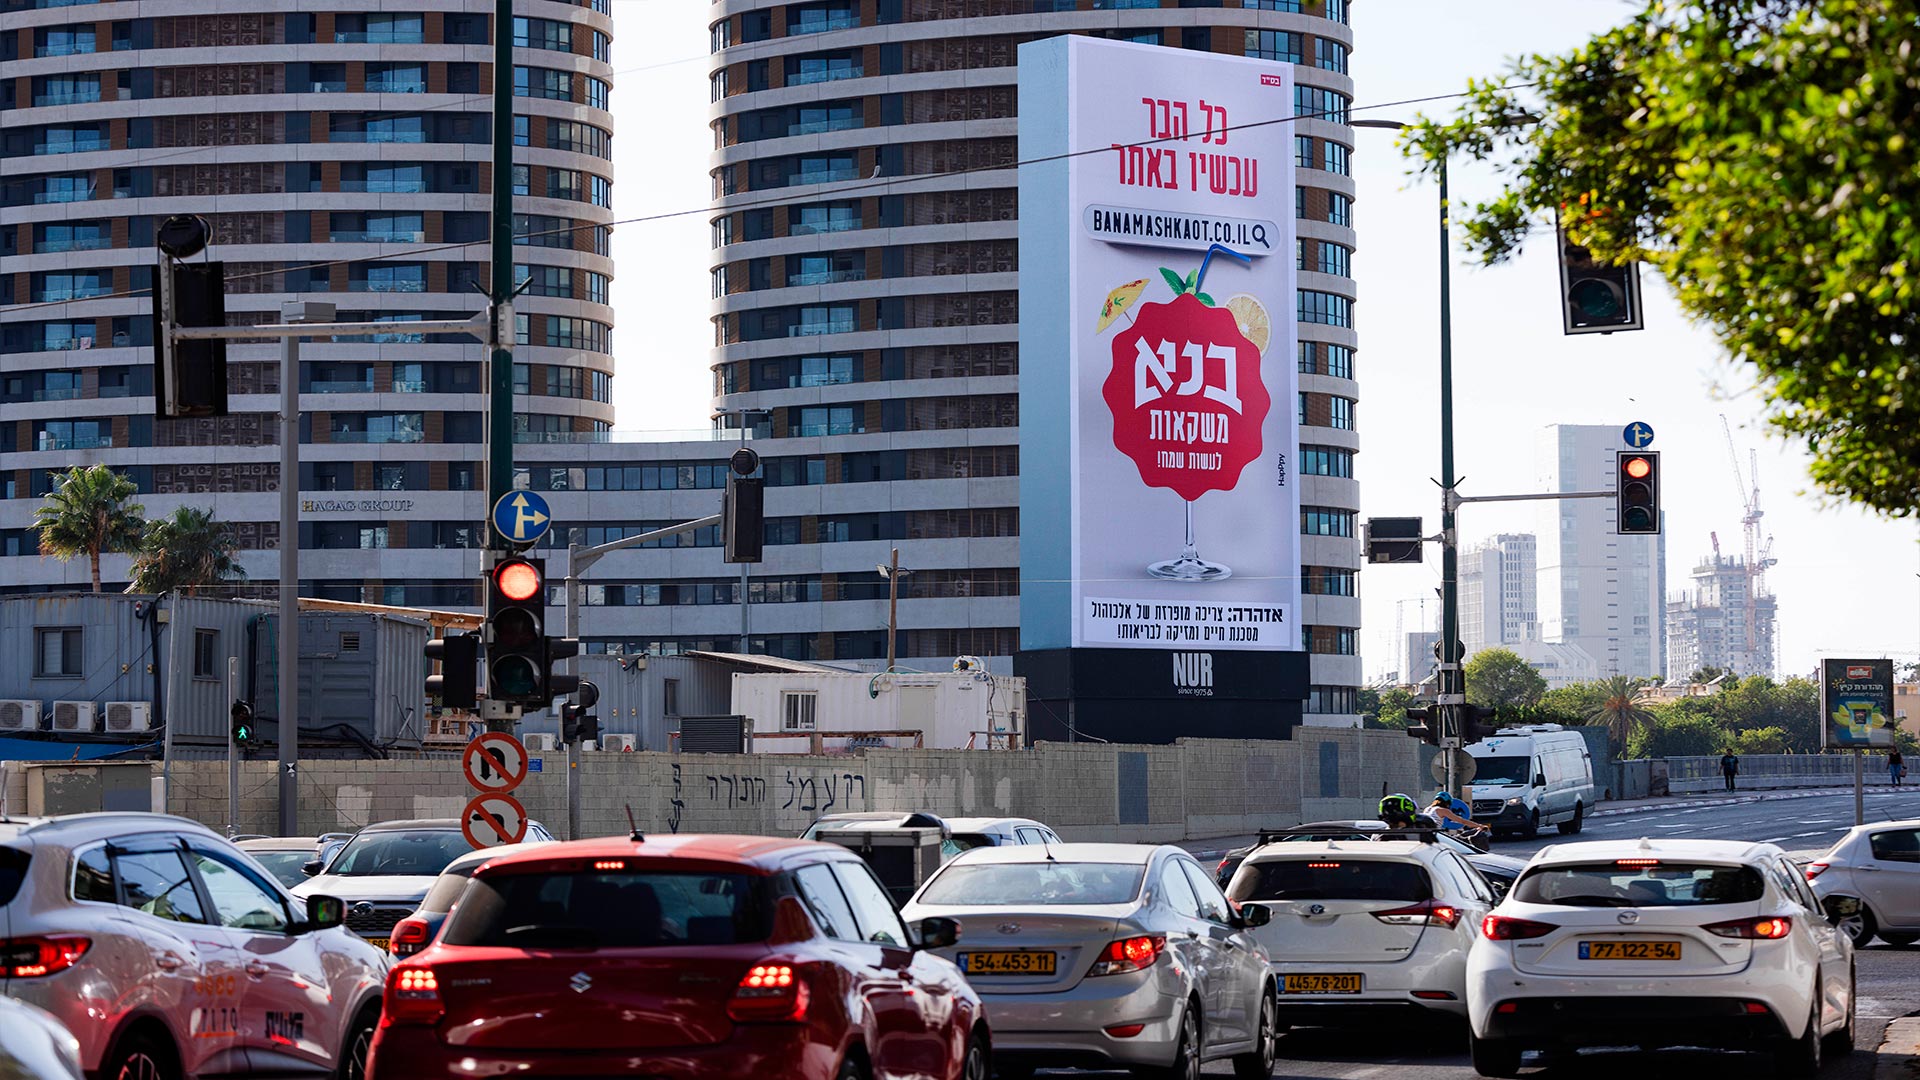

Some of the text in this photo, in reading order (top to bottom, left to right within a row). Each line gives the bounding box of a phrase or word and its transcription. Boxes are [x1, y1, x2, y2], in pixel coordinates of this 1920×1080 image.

[1142, 97, 1228, 145] כל הבר
[1111, 143, 1258, 198] עכשיו באתר
[1093, 209, 1251, 246] BANAMASHKAOT.CO.IL
[1149, 409, 1229, 445] משקאות
[1157, 450, 1222, 471] לעשות שמח!
[302, 500, 414, 512] HAGAG GROUP
[1091, 601, 1283, 623] אזהרה: צריכה מופרזת של אלכוהול
[1117, 623, 1258, 642] מסכנת חיים ומזיקה לבריאות!
[1172, 652, 1213, 688] NUR
[706, 774, 766, 810] התורה
